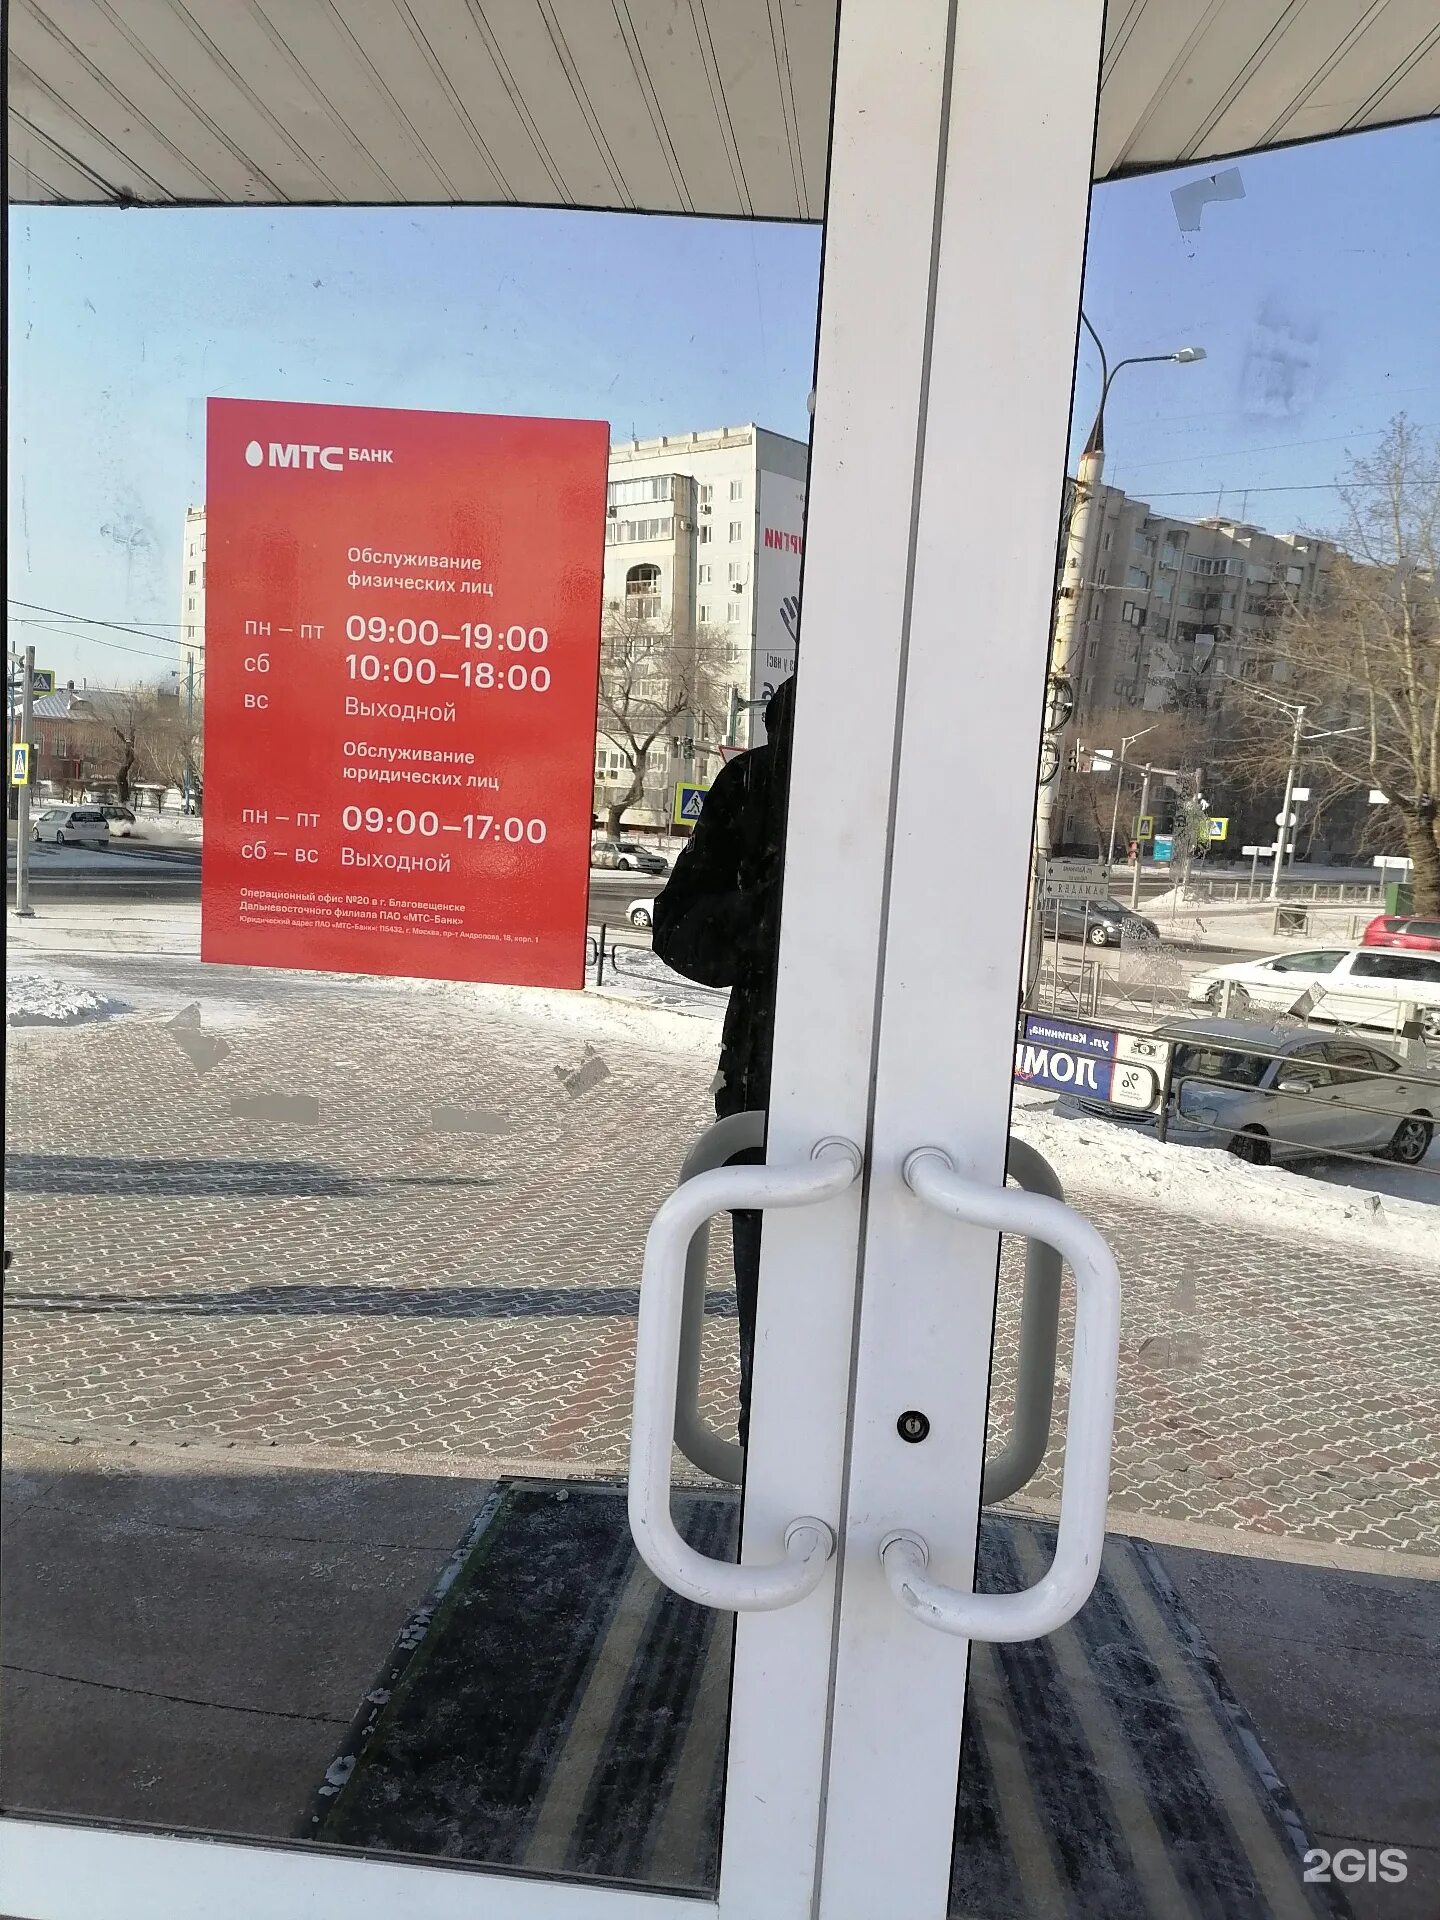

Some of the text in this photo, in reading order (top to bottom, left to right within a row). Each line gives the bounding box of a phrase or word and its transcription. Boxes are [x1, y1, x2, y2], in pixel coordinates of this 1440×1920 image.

[269, 443, 394, 471] МТС БАНК
[348, 547, 482, 570] Обслуживание
[347, 572, 494, 597] физических лиц
[245, 620, 271, 636] пн
[300, 624, 325, 640] пт
[345, 614, 548, 653] 09:00–19:00
[244, 654, 552, 692] сб 10:00–18:00
[244, 692, 456, 722] вс Выходной
[344, 741, 474, 764] Обслуживание
[343, 766, 500, 791] юридических лиц
[242, 809, 268, 825] пн
[296, 812, 320, 829] пт
[342, 806, 547, 844] 09:00–17:00
[241, 841, 267, 860] сб
[295, 847, 318, 864] вс
[341, 847, 451, 873] Выходной
[240, 888, 316, 902] Операционный
[318, 893, 344, 904] офис
[346, 896, 370, 905] №20
[388, 898, 466, 912] Благовещенске
[240, 902, 464, 925] Дальневосточного филиала ПАО «МТС-Банк»
[240, 916, 290, 926] Юридический
[292, 920, 314, 928] адрес
[314, 920, 330, 928] ПАО
[412, 927, 442, 936] Москва,
